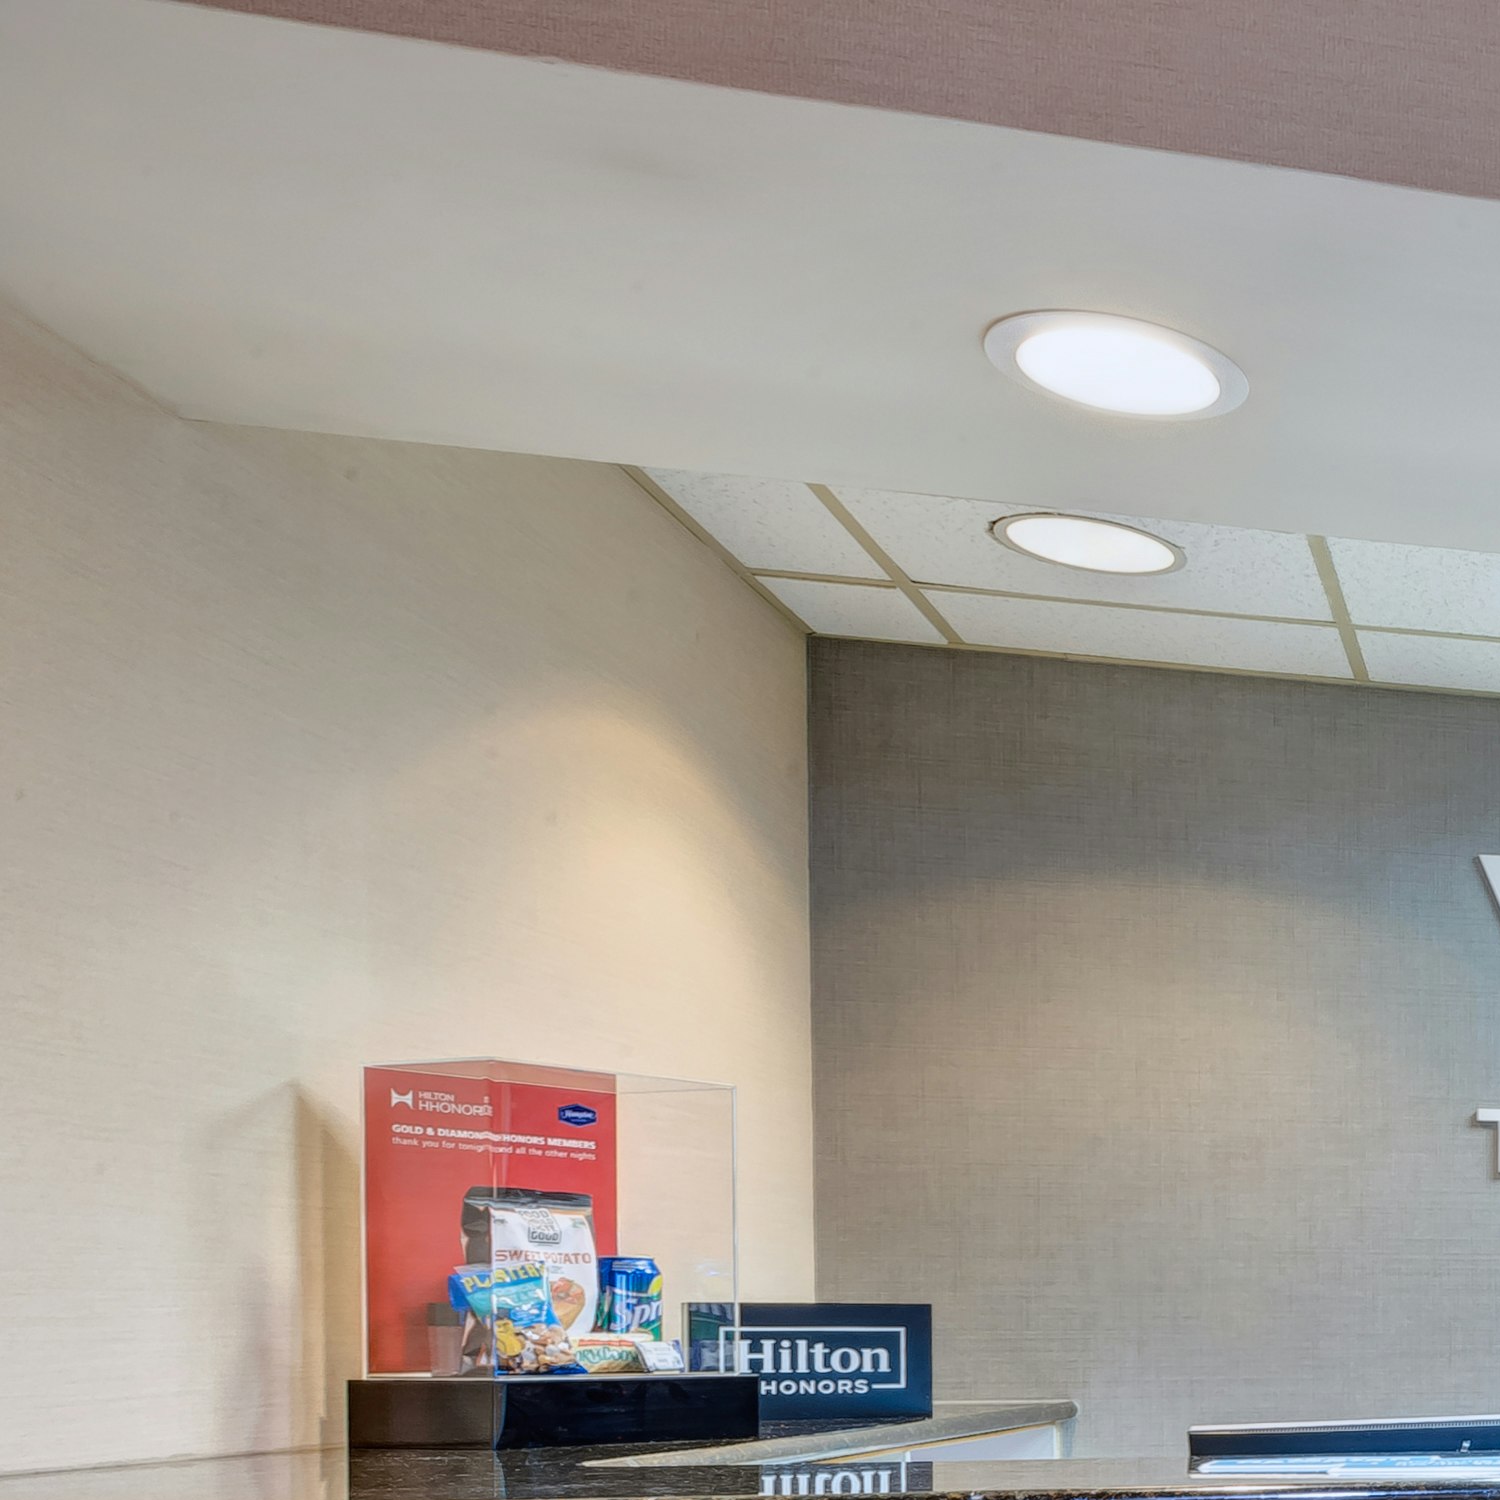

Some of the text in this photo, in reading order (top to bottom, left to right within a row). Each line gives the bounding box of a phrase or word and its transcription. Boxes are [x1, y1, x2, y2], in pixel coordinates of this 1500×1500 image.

[418, 1091, 455, 1101] HILTON
[391, 1124, 596, 1150] GOLD & DIAMON HONORS MEMBERS
[391, 1137, 419, 1146] thank
[422, 1140, 440, 1149] you
[442, 1140, 456, 1149] for
[459, 1142, 488, 1153] tonig
[515, 1147, 527, 1155] all
[528, 1147, 543, 1156] the
[544, 1149, 568, 1158] other
[495, 1249, 592, 1265] SWEET POTATO
[738, 1339, 892, 1374] Hilton
[760, 1379, 869, 1395] HONORS
